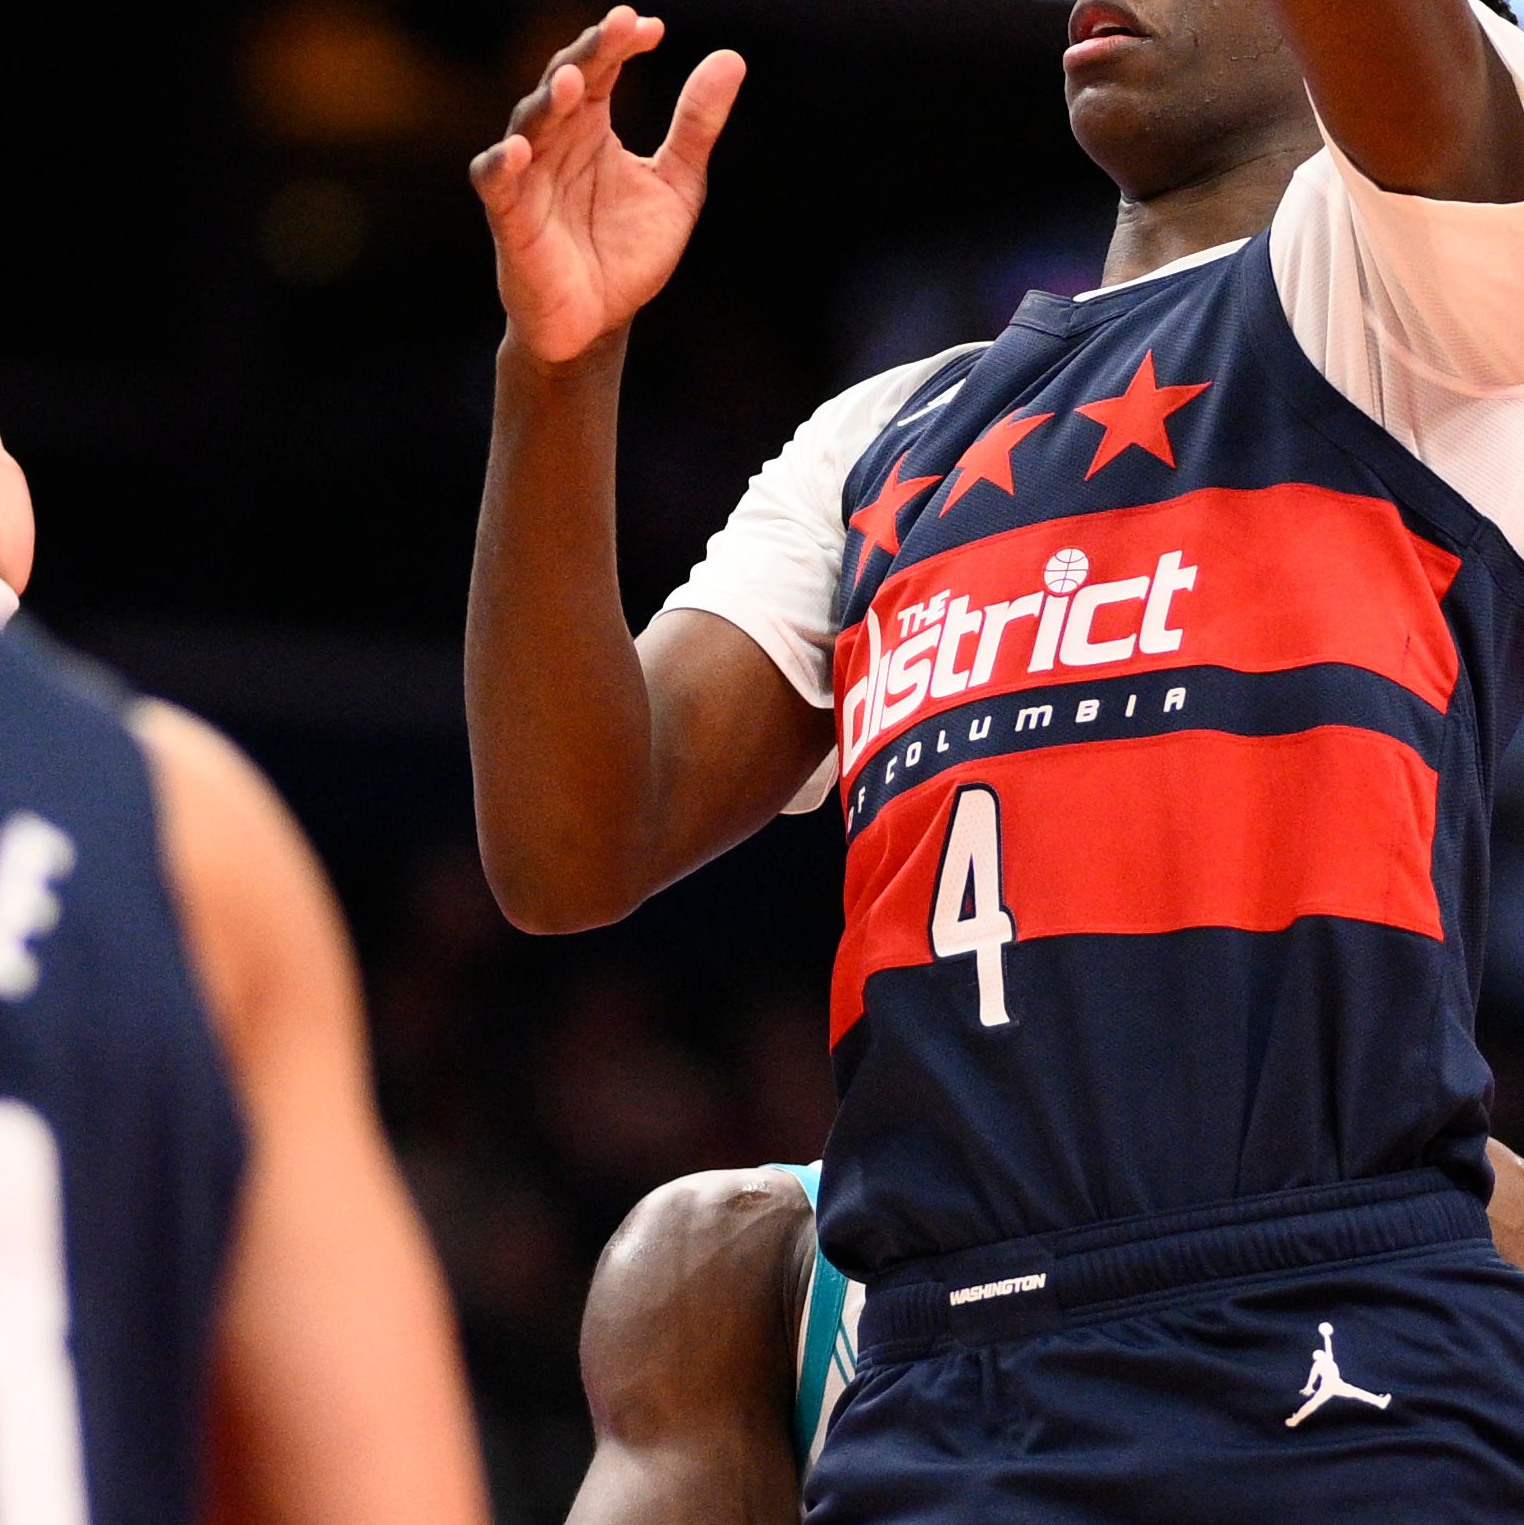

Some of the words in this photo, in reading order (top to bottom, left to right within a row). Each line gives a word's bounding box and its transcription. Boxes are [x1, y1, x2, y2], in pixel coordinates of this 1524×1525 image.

[841, 547, 1198, 778] district
[897, 588, 951, 638] THE
[884, 686, 1187, 785] COLUMBIA
[930, 786, 1014, 1028] 4
[949, 1272, 1047, 1307] WASHINGTON
